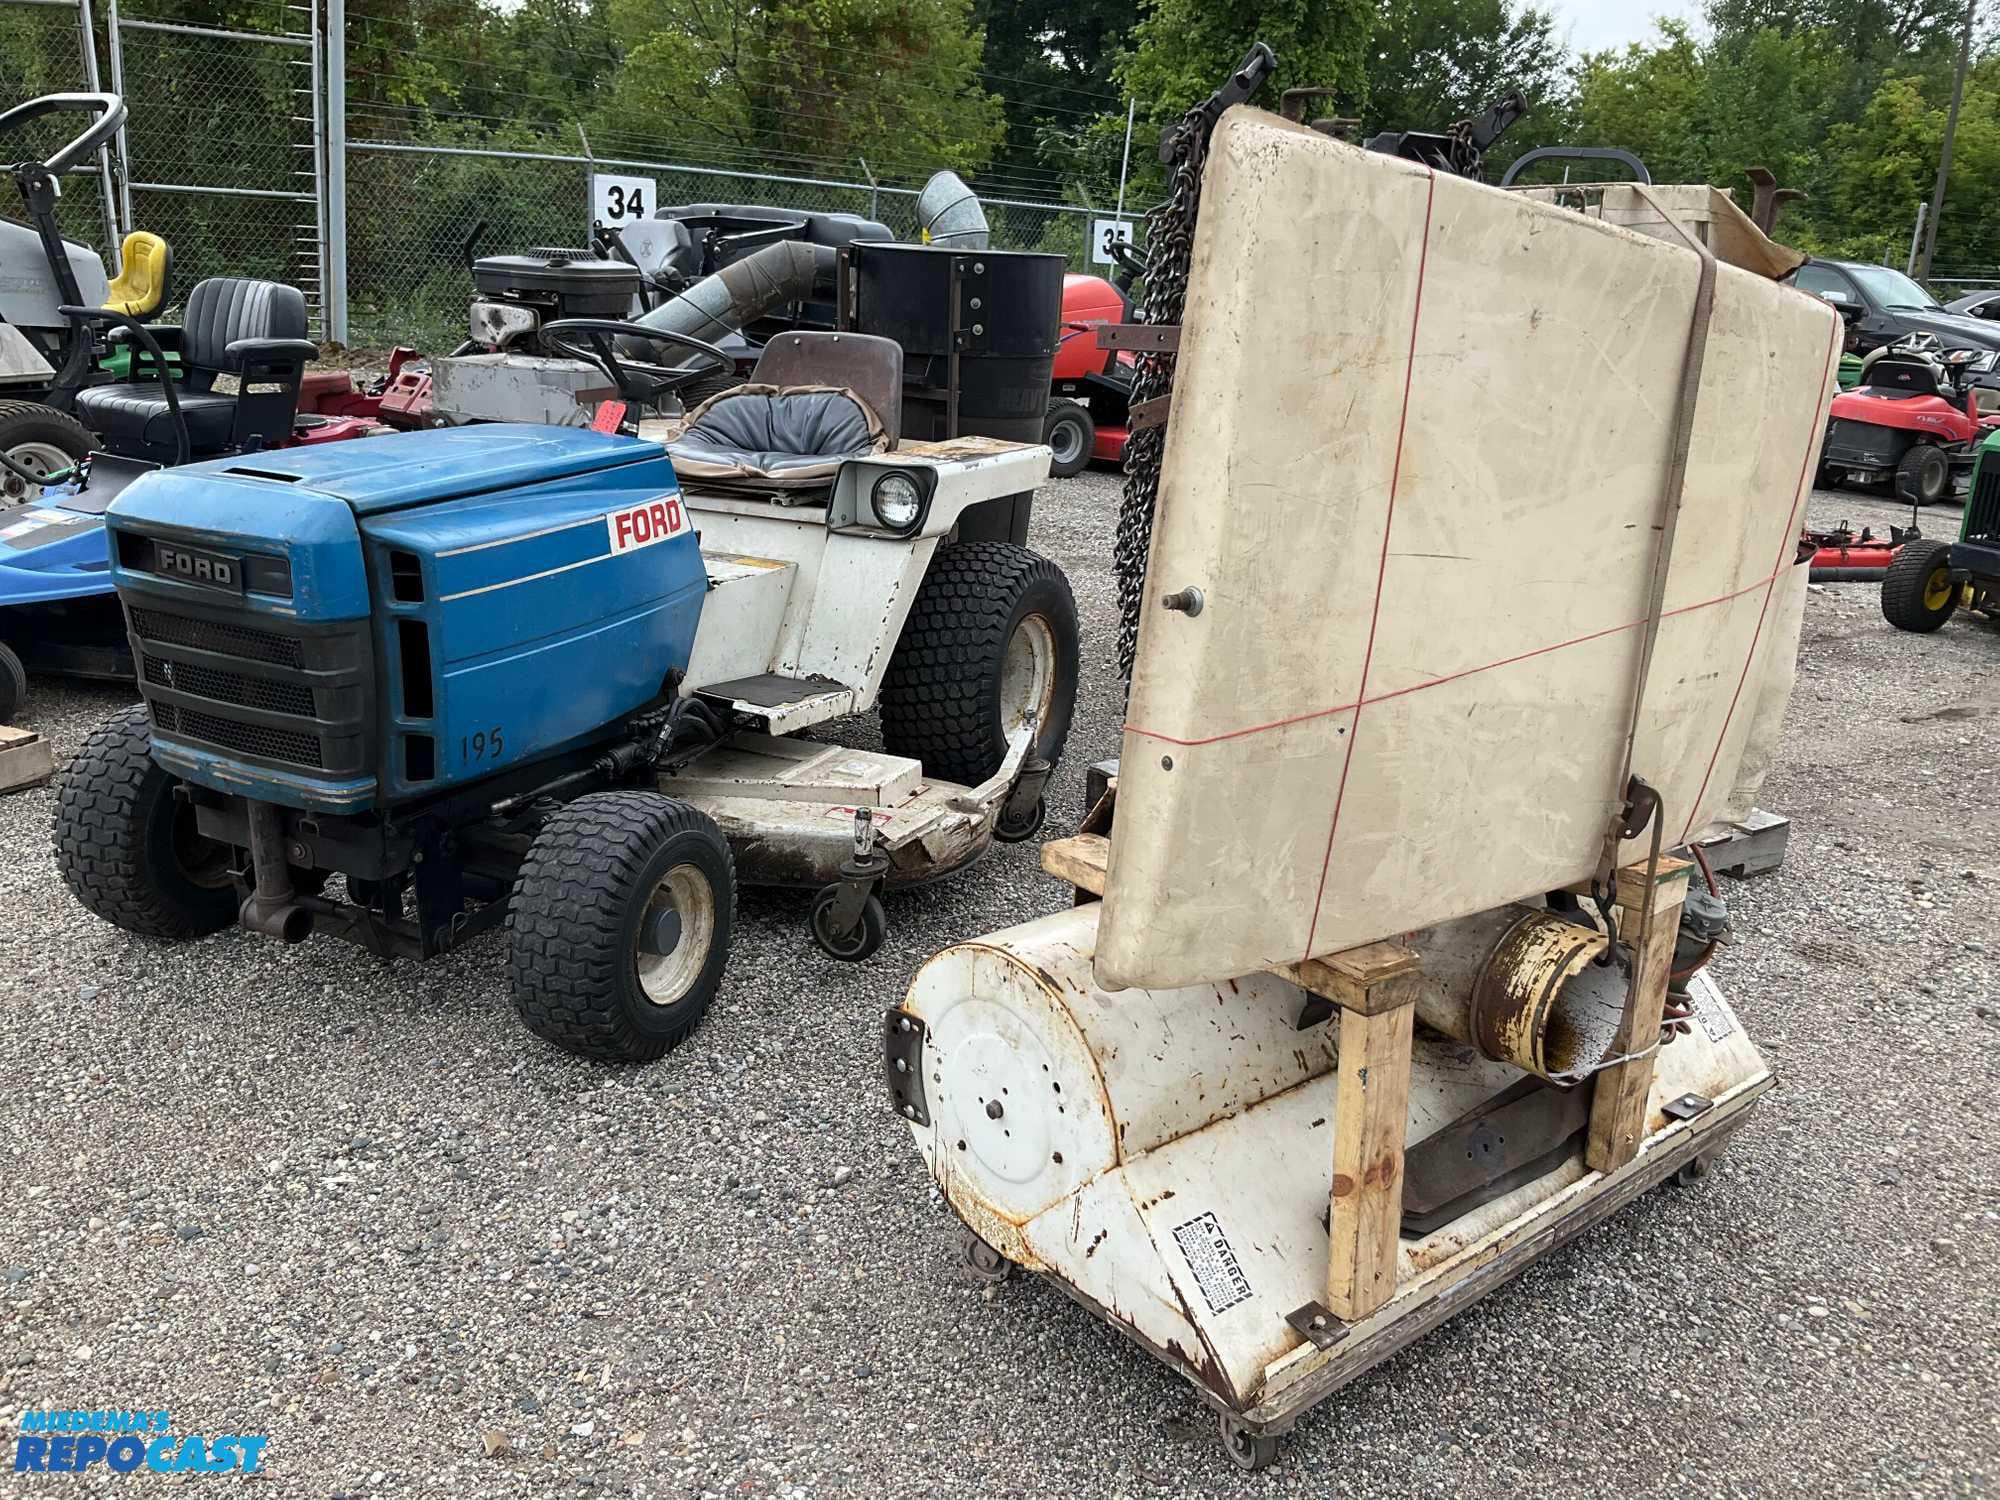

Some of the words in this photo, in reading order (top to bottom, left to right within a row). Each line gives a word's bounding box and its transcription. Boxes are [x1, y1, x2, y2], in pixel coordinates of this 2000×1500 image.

[607, 185, 645, 220] 34
[614, 499, 681, 549] FORD
[160, 549, 231, 584] FORD
[461, 726, 503, 766] 195
[1213, 1238, 1247, 1295] DANGER
